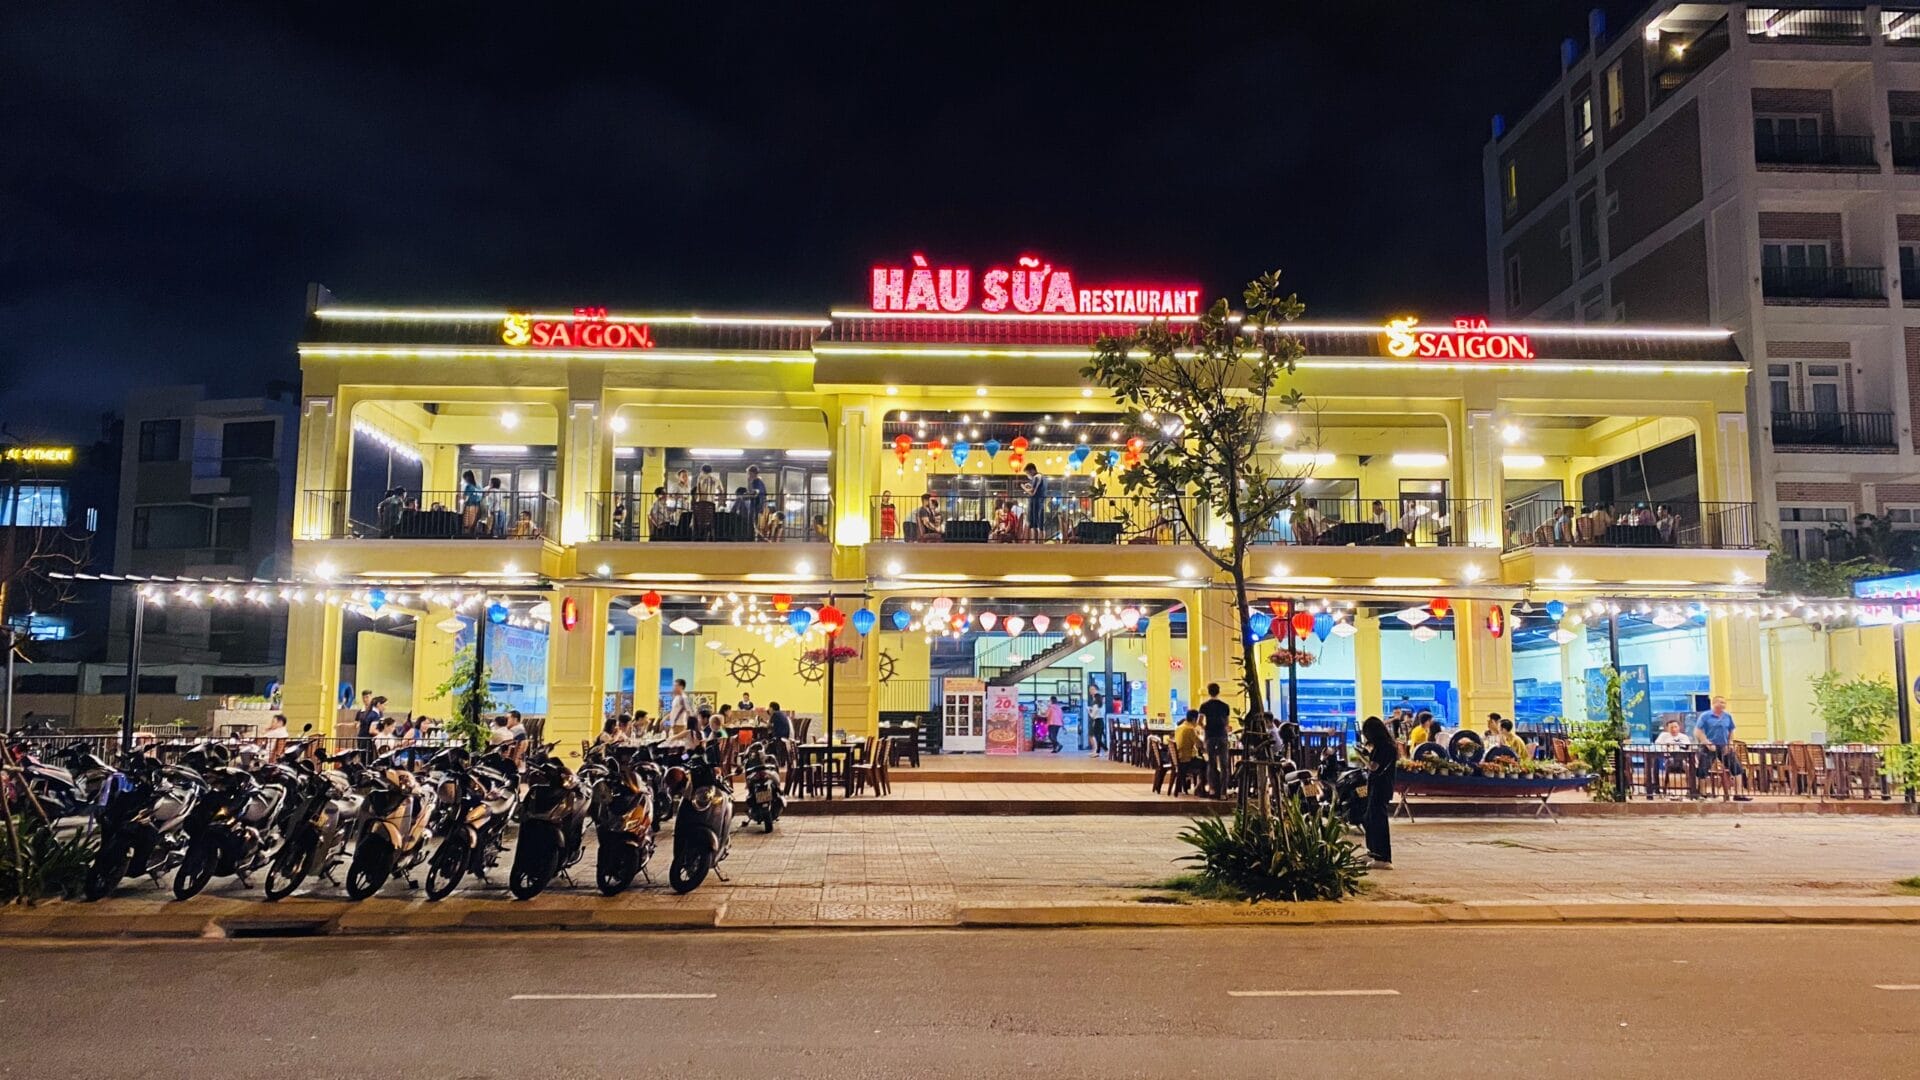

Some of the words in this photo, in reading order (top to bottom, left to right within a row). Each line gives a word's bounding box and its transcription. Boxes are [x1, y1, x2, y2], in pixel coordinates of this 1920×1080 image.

[873, 255, 969, 311] HÀU
[981, 256, 1076, 312] SỮA
[1080, 290, 1198, 313] RESTAURANT
[574, 308, 607, 322] BIA
[1455, 319, 1488, 334] BIA
